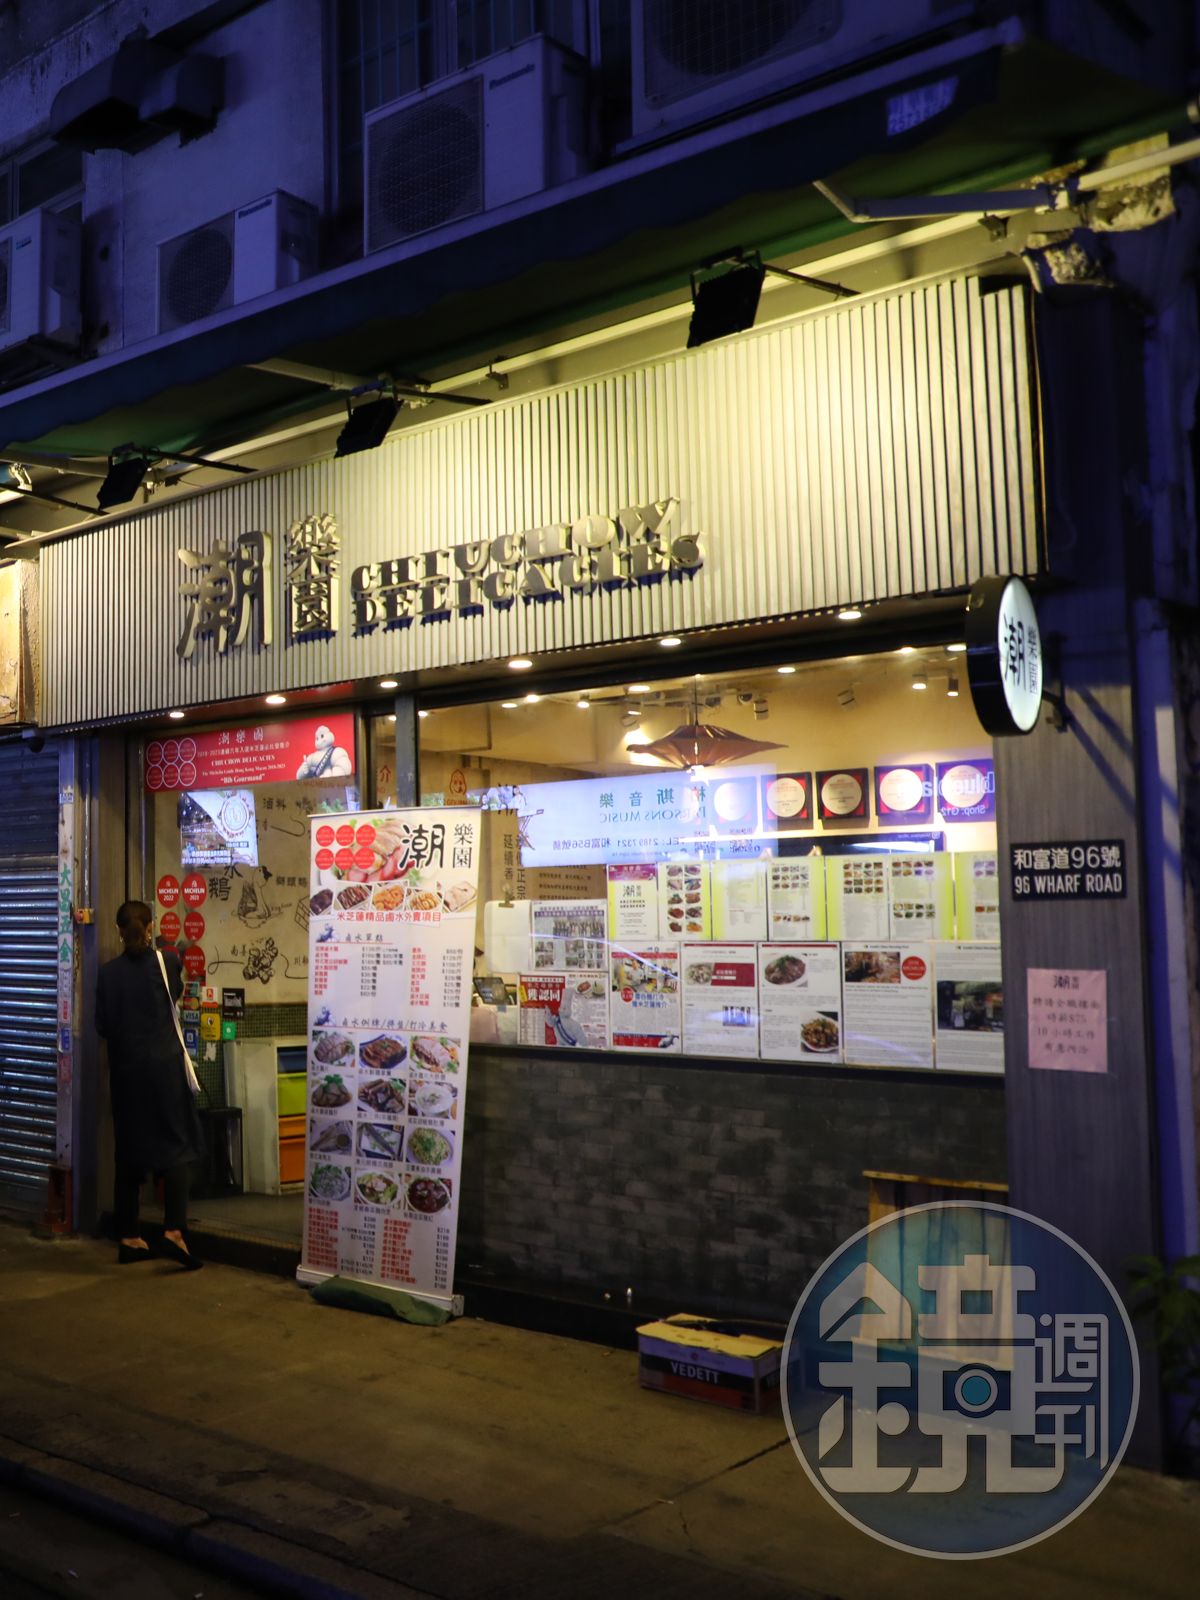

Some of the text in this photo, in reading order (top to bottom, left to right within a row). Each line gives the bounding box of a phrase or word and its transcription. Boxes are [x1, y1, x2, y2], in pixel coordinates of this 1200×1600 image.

[352, 532, 706, 635] DELICACIES
[1014, 846, 1121, 870] 和富道96號
[1014, 873, 1122, 894] 96 WHARF ROAD
[671, 1361, 721, 1385] VEDETT
